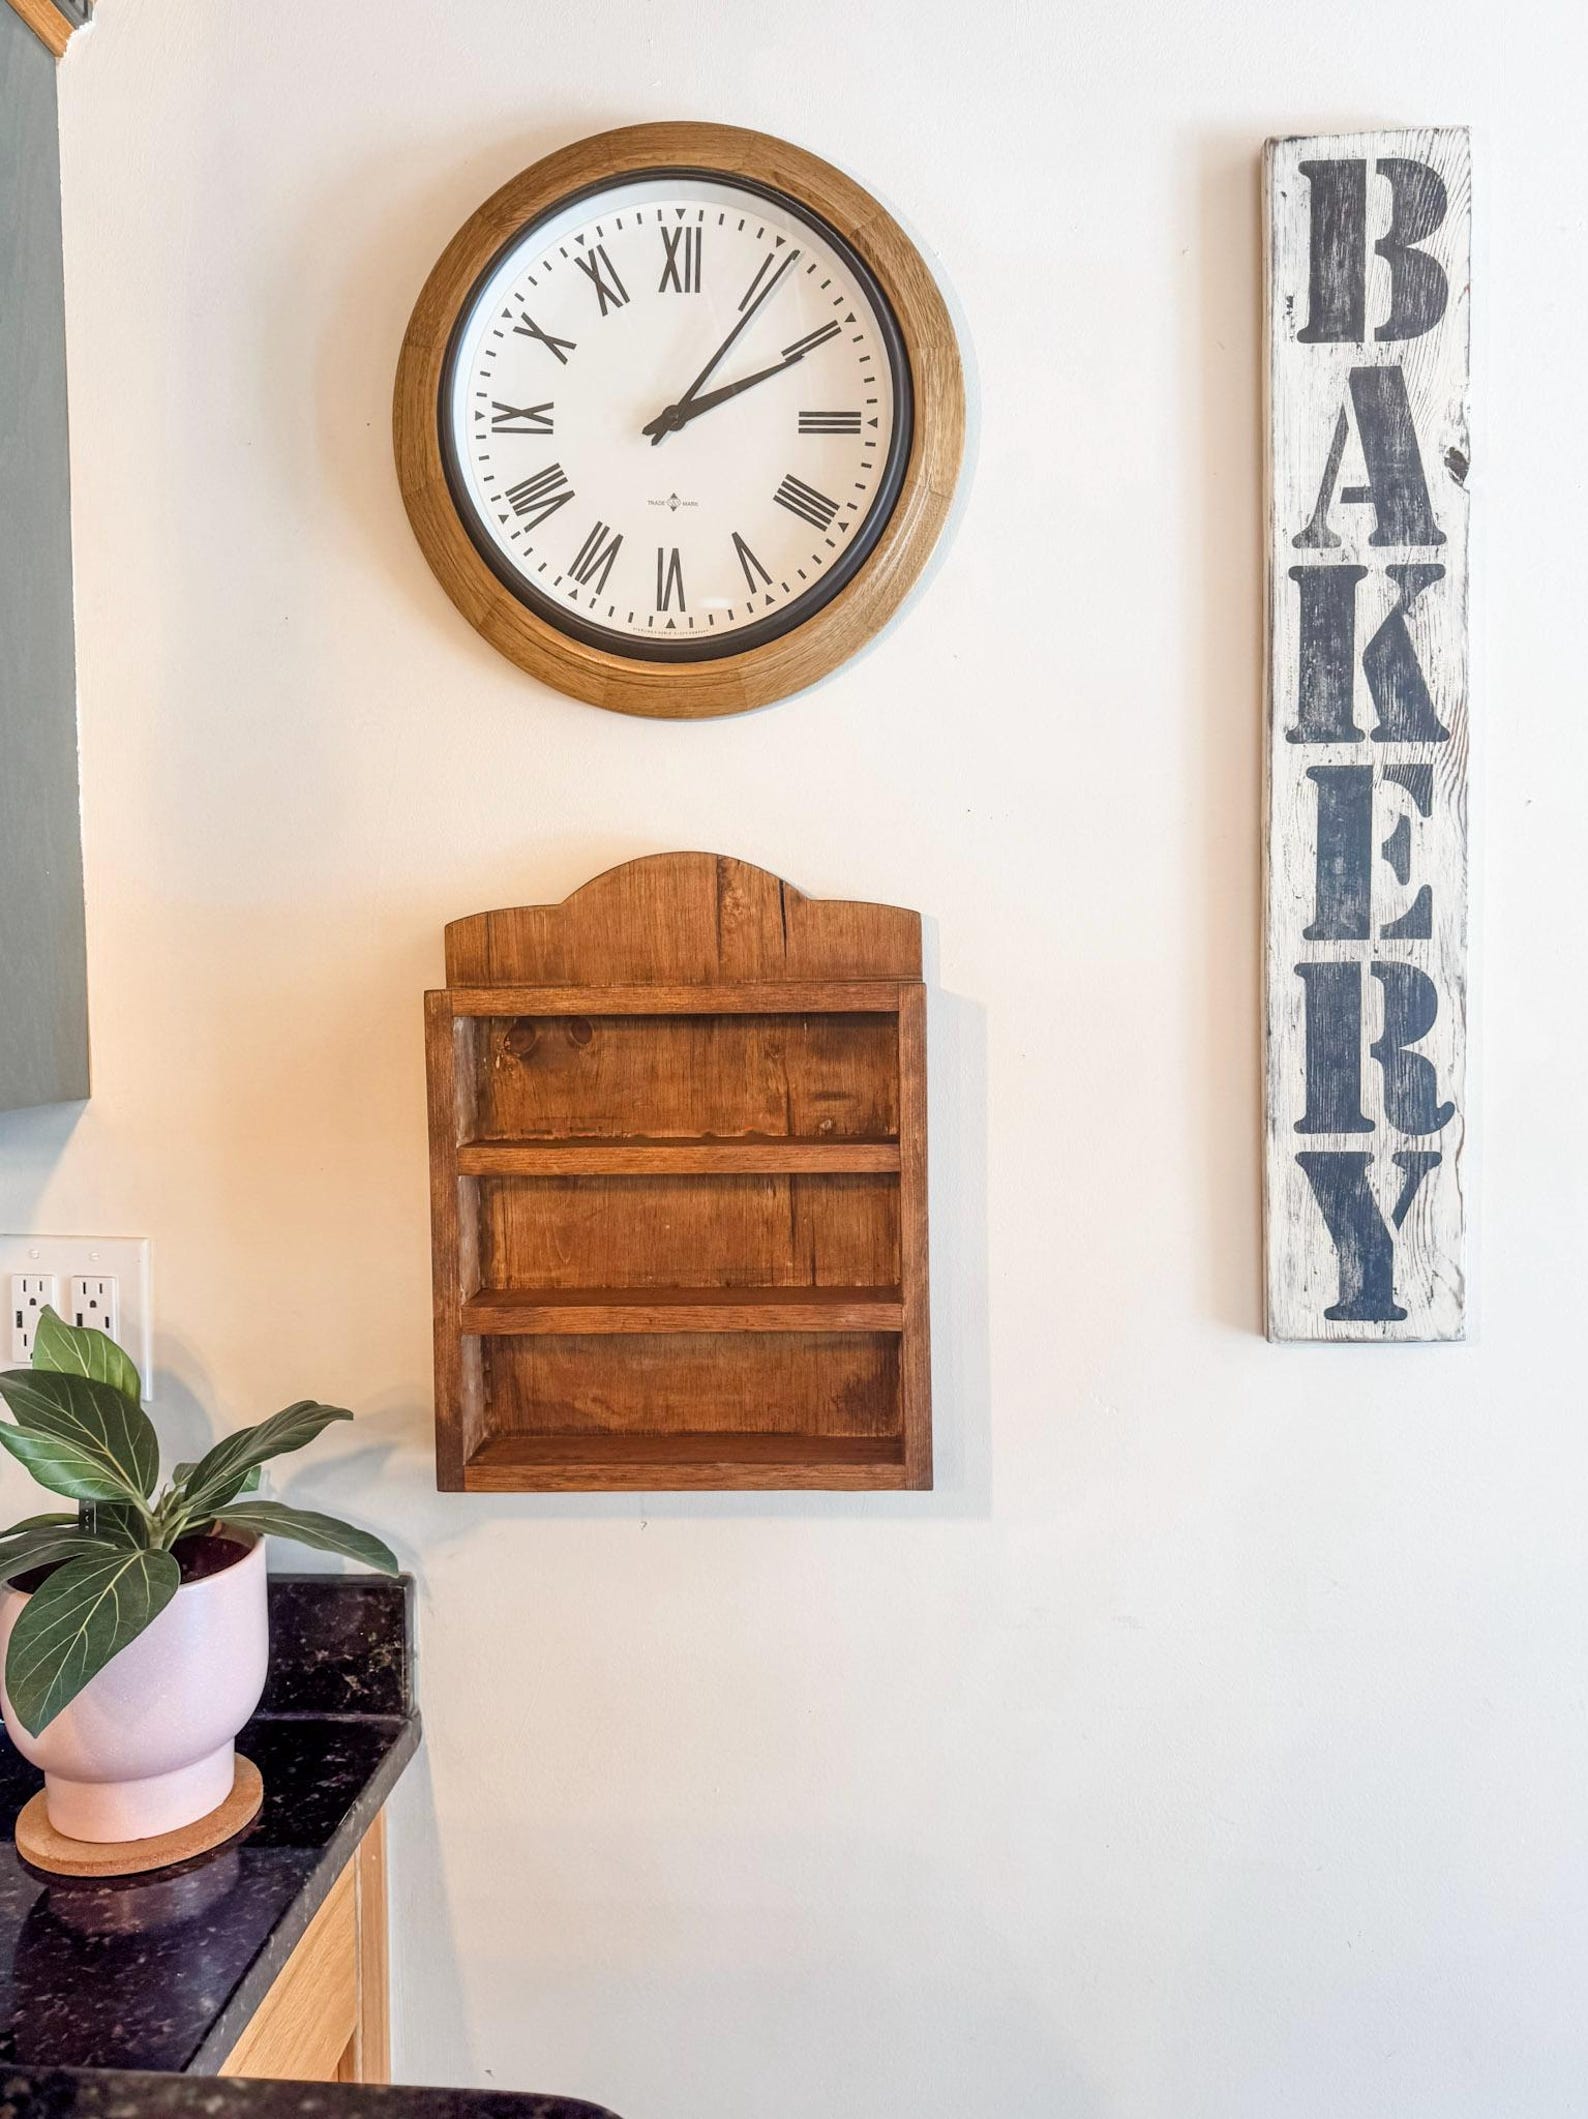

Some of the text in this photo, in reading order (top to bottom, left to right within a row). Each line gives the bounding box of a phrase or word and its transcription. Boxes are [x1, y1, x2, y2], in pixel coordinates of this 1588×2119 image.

[574, 244, 631, 317] XI
[658, 226, 703, 294] XII
[512, 312, 577, 365] X
[491, 401, 555, 435] IX
[798, 411, 862, 435] III
[504, 462, 576, 533] VIII
[567, 521, 624, 596] VII
[656, 547, 686, 613] VI
[731, 531, 774, 595] V
[1284, 158, 1455, 1324] BAKERY
